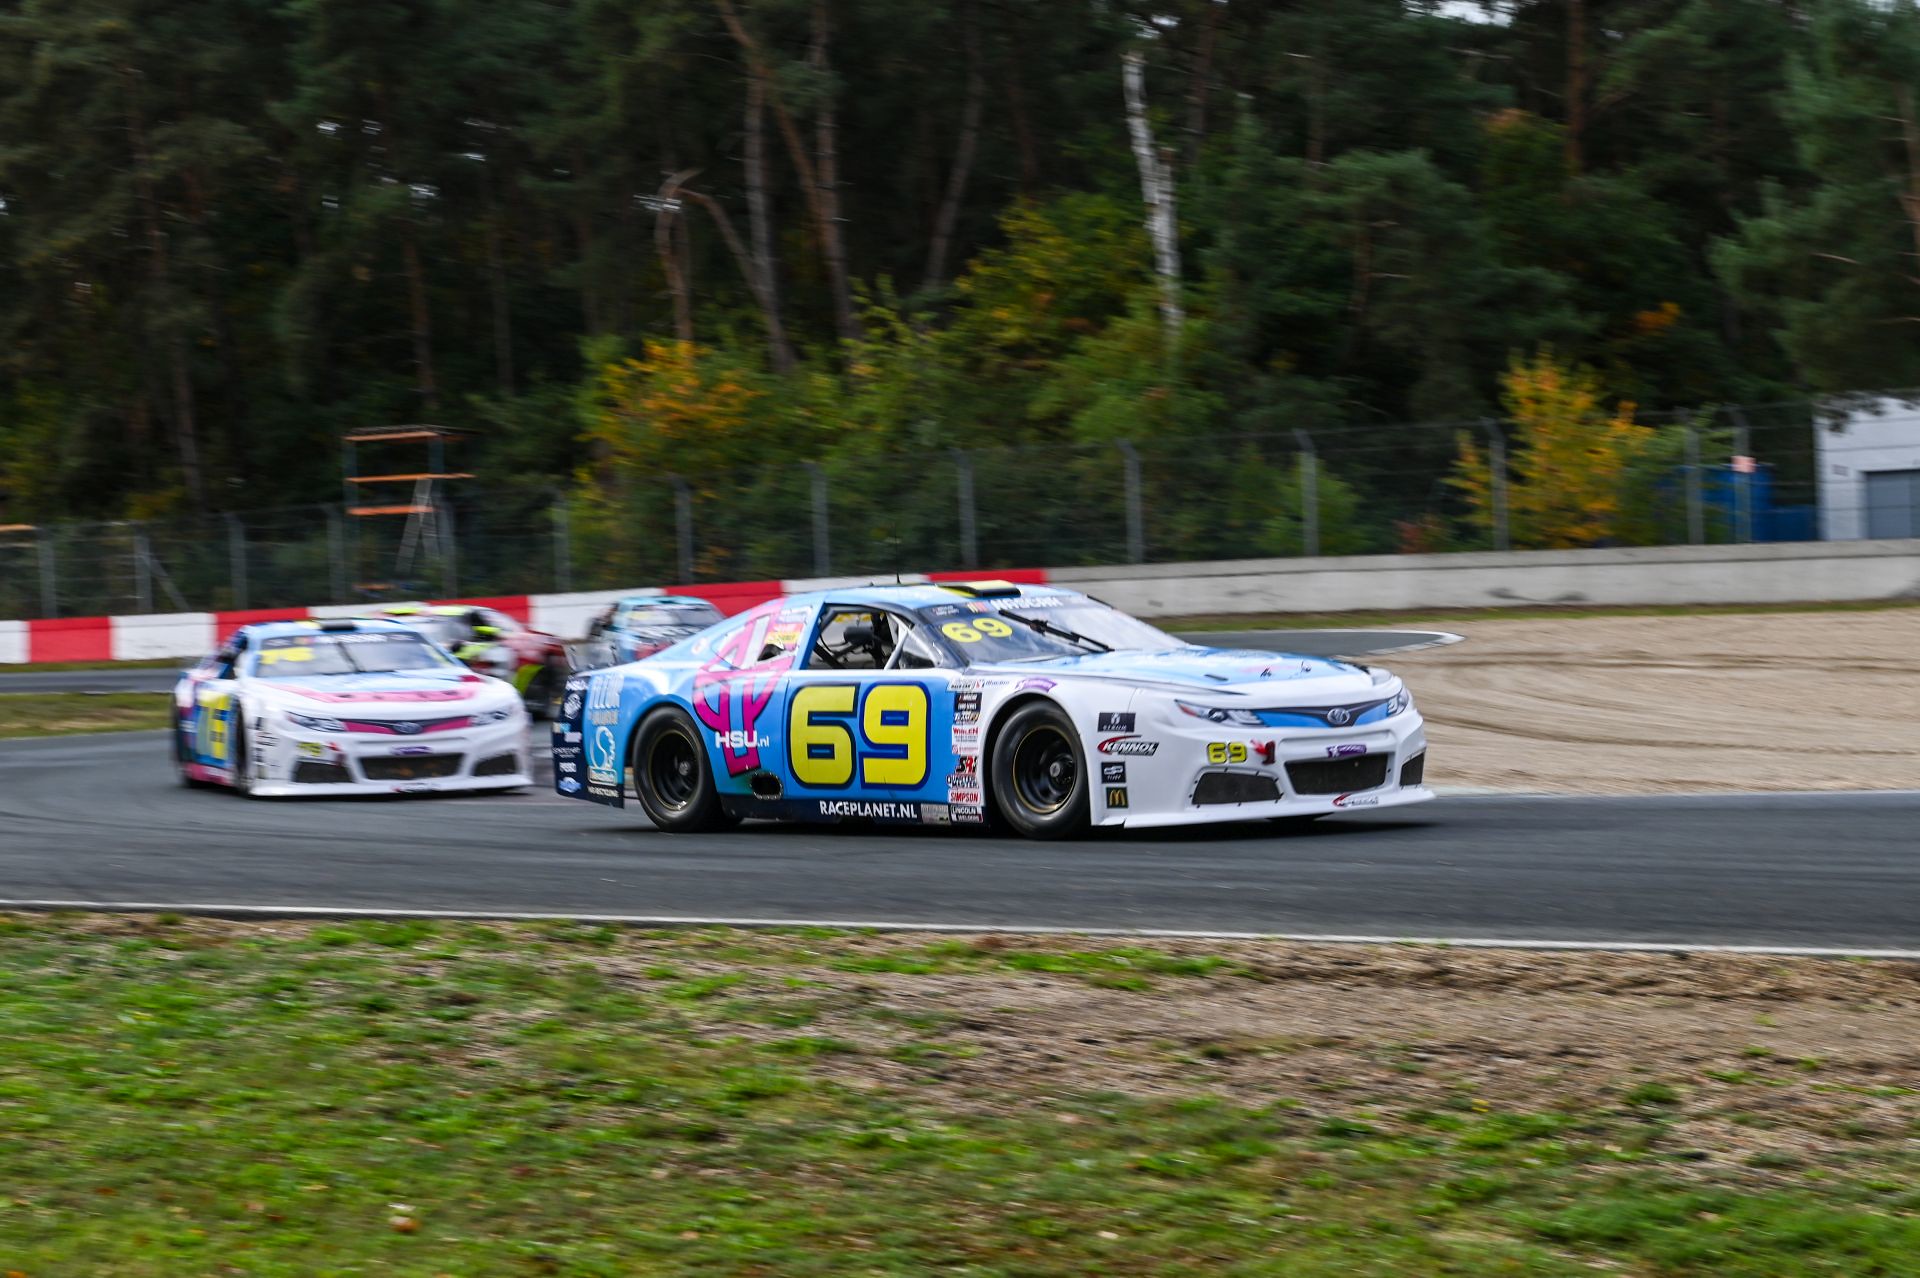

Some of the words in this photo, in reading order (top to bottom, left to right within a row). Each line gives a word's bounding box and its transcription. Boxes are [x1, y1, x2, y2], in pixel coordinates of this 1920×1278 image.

[941, 617, 1013, 643] 69
[715, 730, 770, 749] HSU.nl
[787, 682, 930, 790] 69
[1102, 741, 1157, 754] KENNOL
[1207, 742, 1247, 765] 69
[950, 792, 979, 803] SIMPSON
[819, 800, 918, 819] RACEPLANET.NL
[952, 806, 976, 815] LINCOLN
